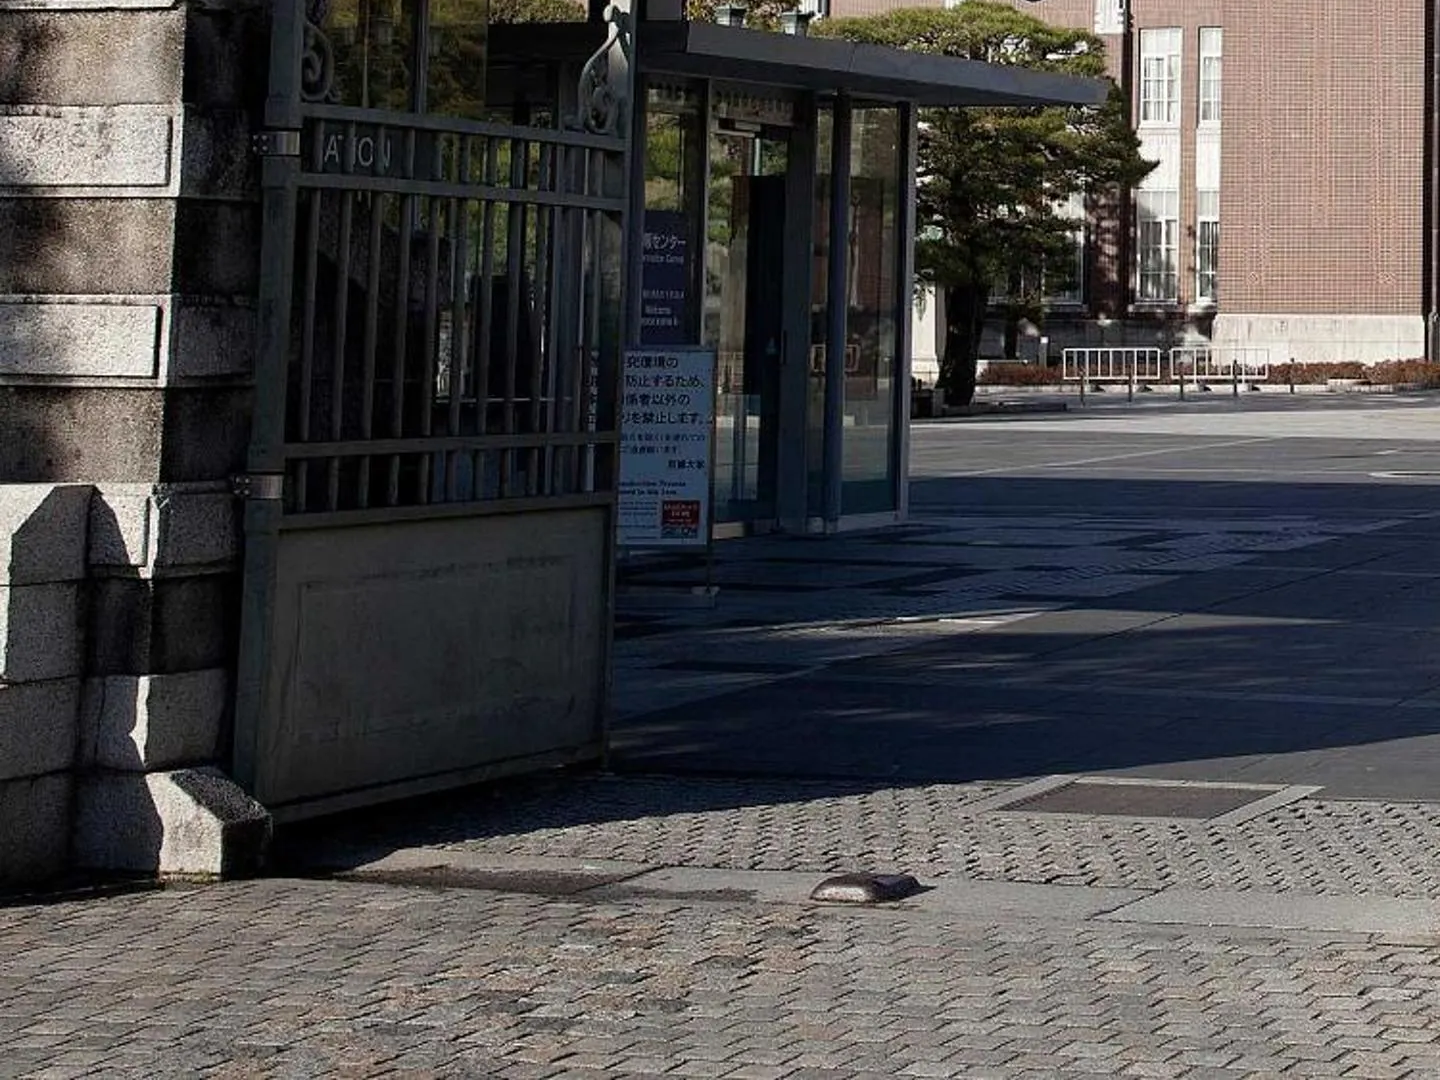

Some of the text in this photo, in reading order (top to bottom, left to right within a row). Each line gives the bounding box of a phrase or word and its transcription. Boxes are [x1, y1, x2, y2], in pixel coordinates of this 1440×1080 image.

[621, 393, 691, 406] 係者以外の
